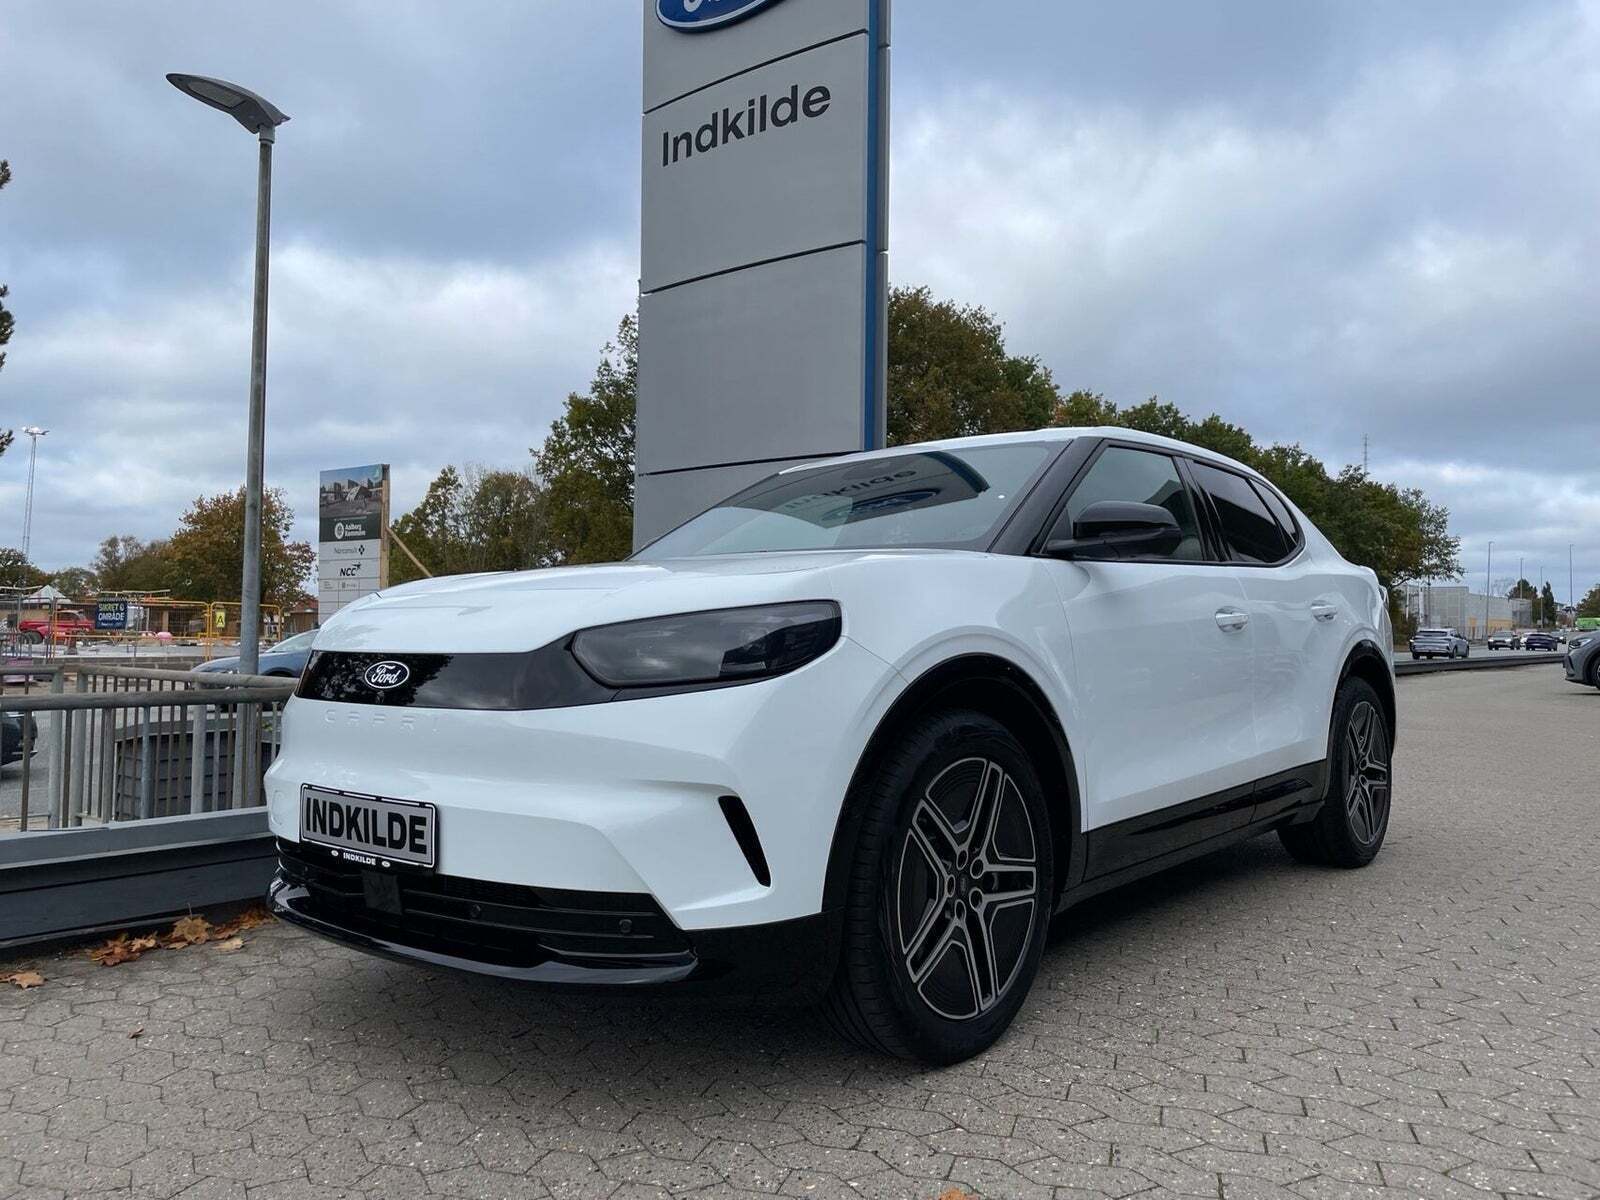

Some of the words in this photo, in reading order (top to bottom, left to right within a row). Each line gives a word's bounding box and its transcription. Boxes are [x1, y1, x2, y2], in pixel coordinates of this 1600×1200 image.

[662, 84, 831, 167] Indkilde
[340, 567, 357, 577] NCC
[371, 664, 399, 685] Ford
[306, 797, 427, 855] INDKILDE
[343, 852, 376, 866] INDKILDE
